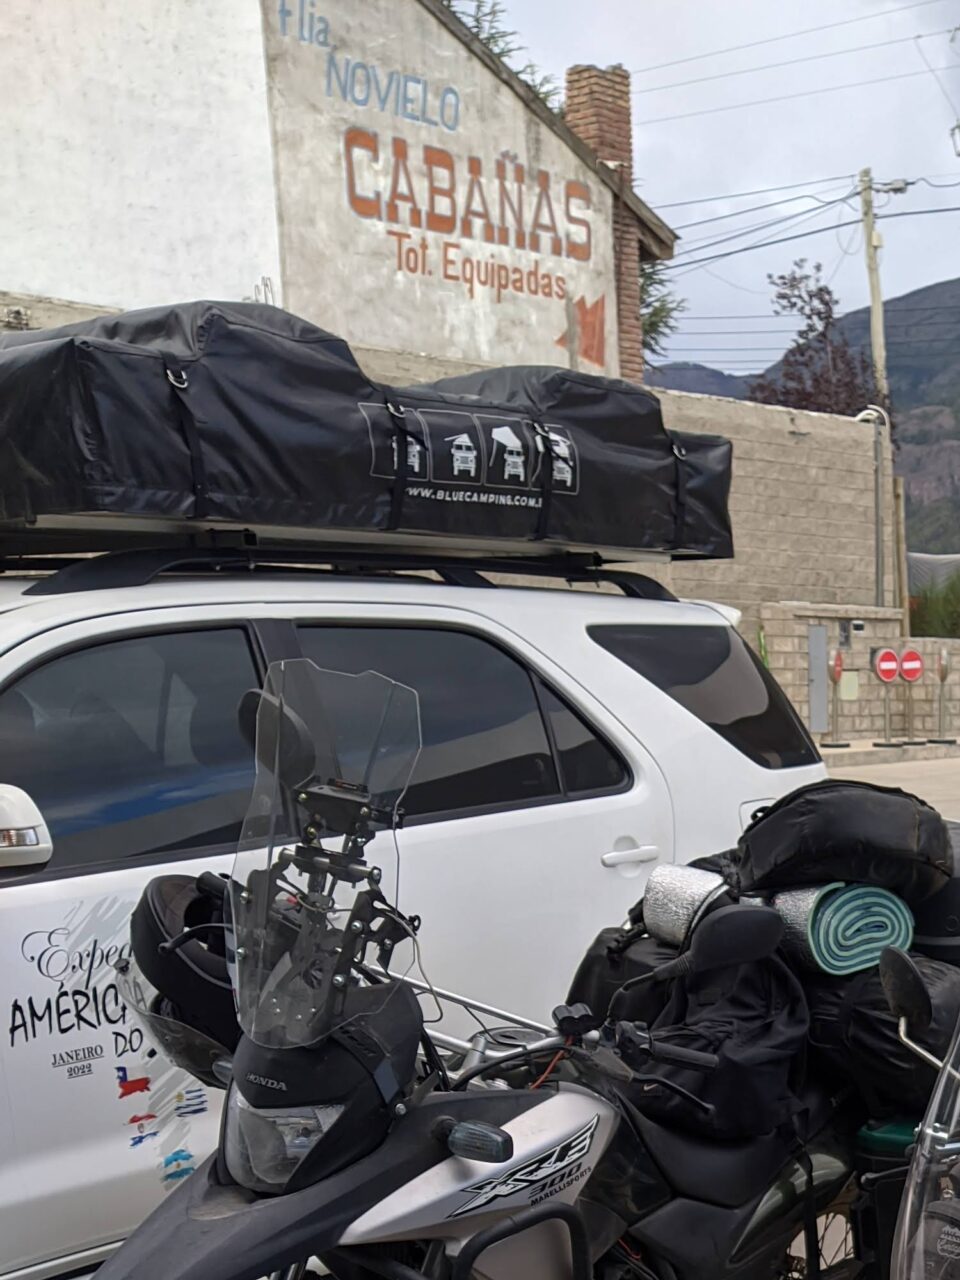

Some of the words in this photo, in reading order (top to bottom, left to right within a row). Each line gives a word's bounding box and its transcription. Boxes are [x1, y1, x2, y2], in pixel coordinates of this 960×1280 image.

[326, 51, 461, 132] NOVIELO
[343, 127, 593, 263] CABAÑAS
[443, 242, 567, 303] Equipadas
[51, 1044, 104, 1067] JANEIRO
[67, 1063, 93, 1077] 2022
[246, 1072, 288, 1091] HONDA
[527, 1162, 583, 1199] 300
[530, 1166, 593, 1207] MARELLISPORTS
